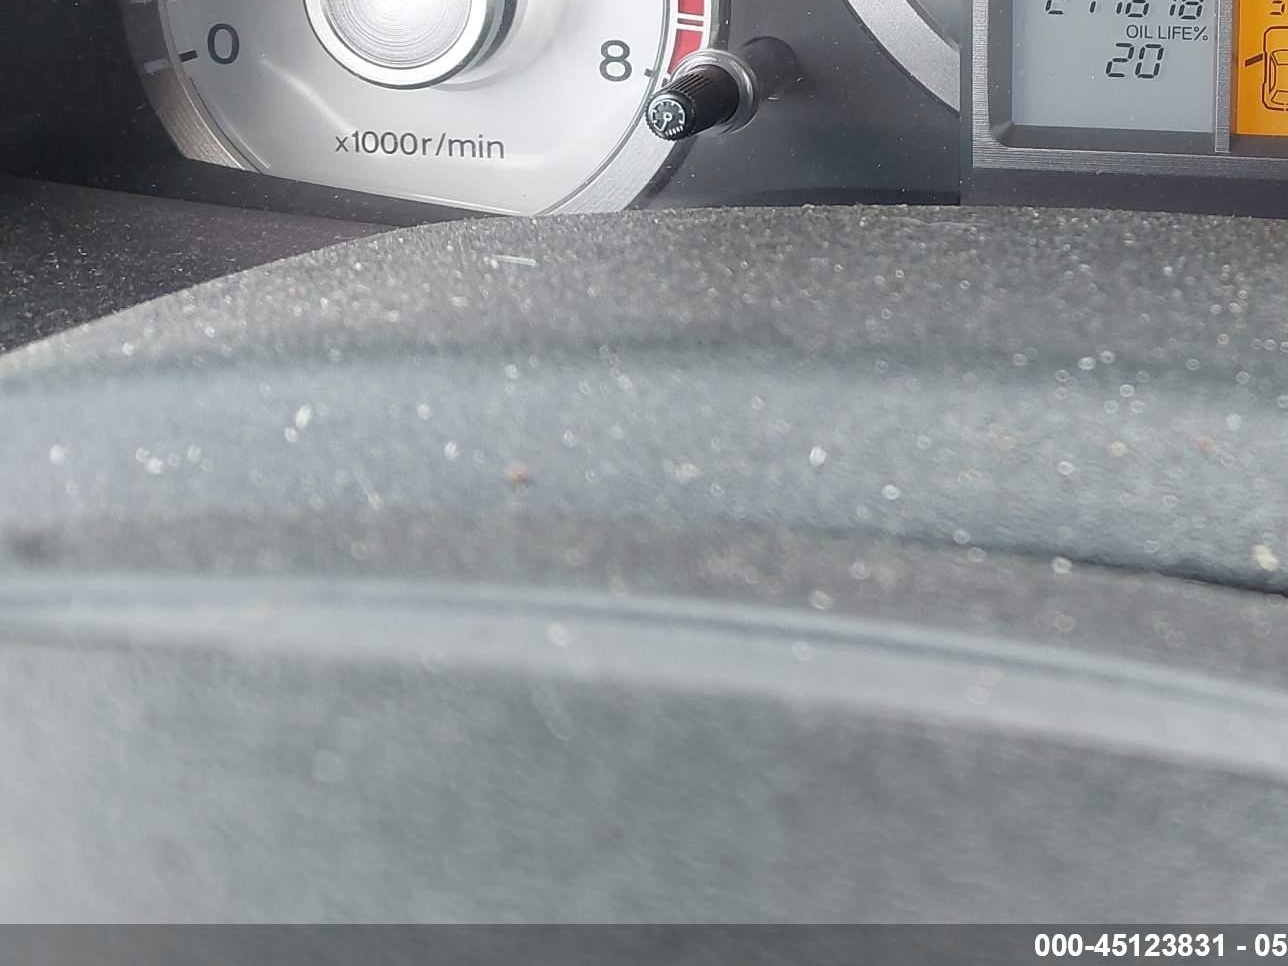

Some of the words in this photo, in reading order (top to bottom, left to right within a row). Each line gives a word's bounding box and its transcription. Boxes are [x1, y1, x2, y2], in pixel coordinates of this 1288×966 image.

[207, 23, 240, 65] 0
[1125, 24, 1154, 40] OIL
[1157, 25, 1209, 42] LIFE%
[600, 39, 632, 82] 8
[1105, 42, 1164, 79] 20
